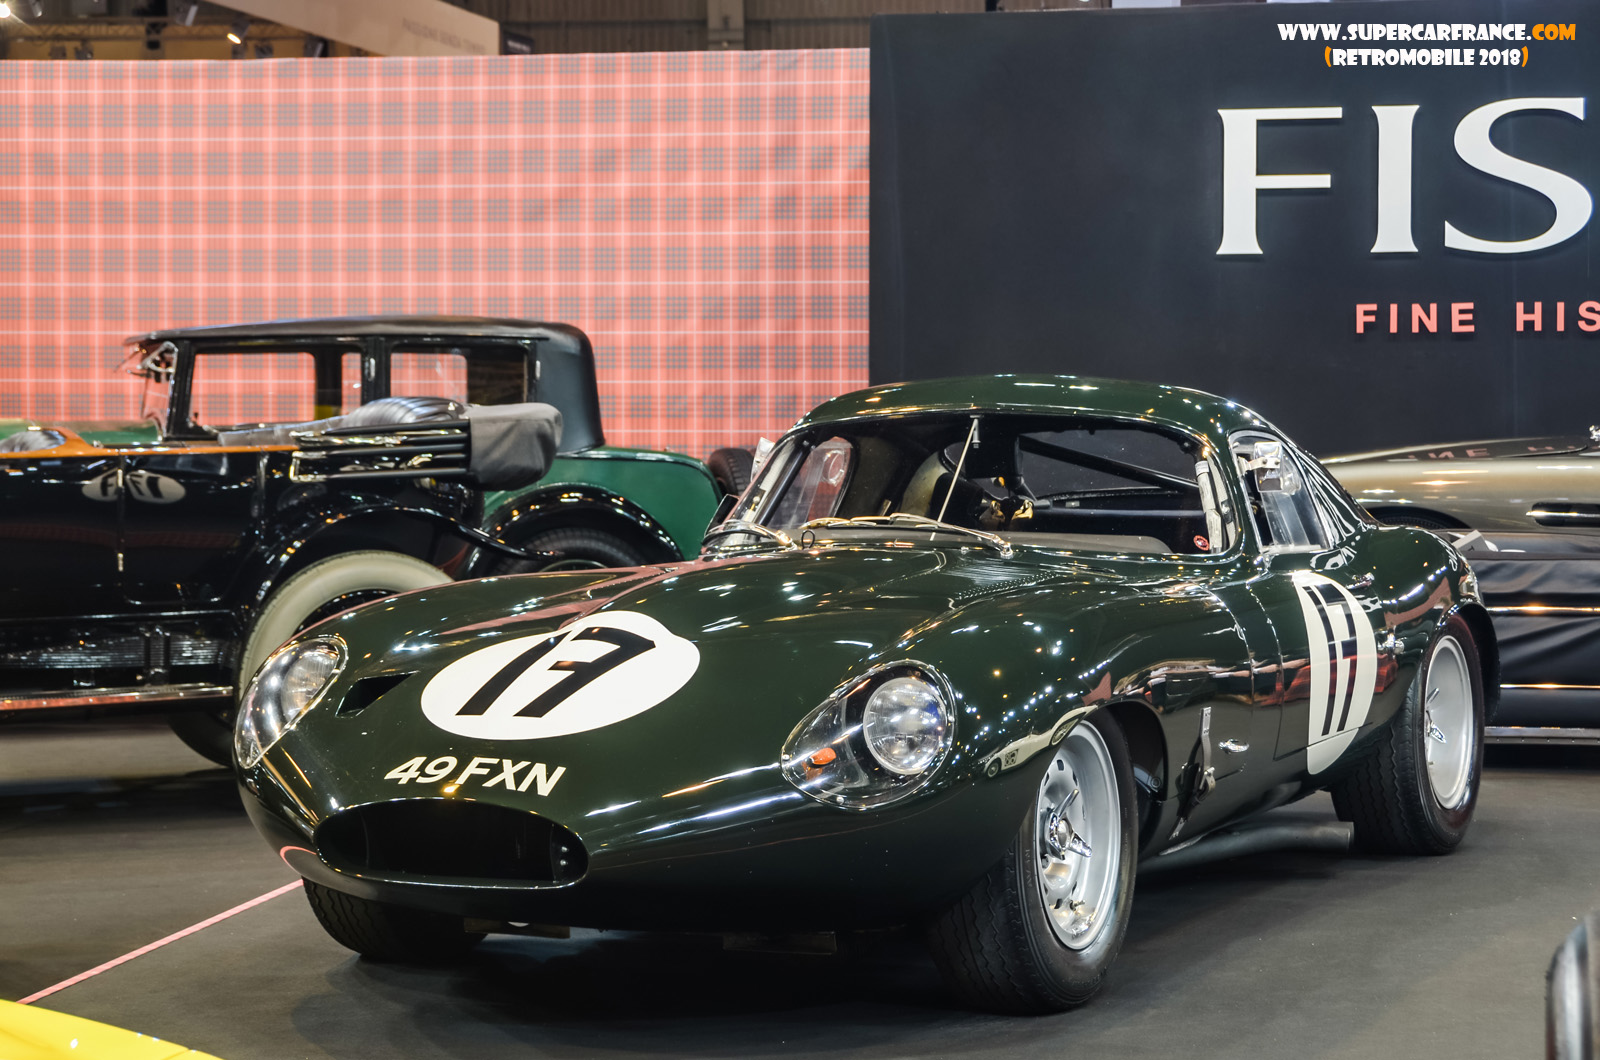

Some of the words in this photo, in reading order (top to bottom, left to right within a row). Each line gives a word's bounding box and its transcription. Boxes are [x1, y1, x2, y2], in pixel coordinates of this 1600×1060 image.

[1216, 97, 1594, 255] FIS
[1355, 302, 1475, 334] FINE
[1515, 300, 1600, 332] HIS
[455, 626, 657, 719] 17
[383, 756, 458, 785] 49
[454, 756, 567, 797] FXN
